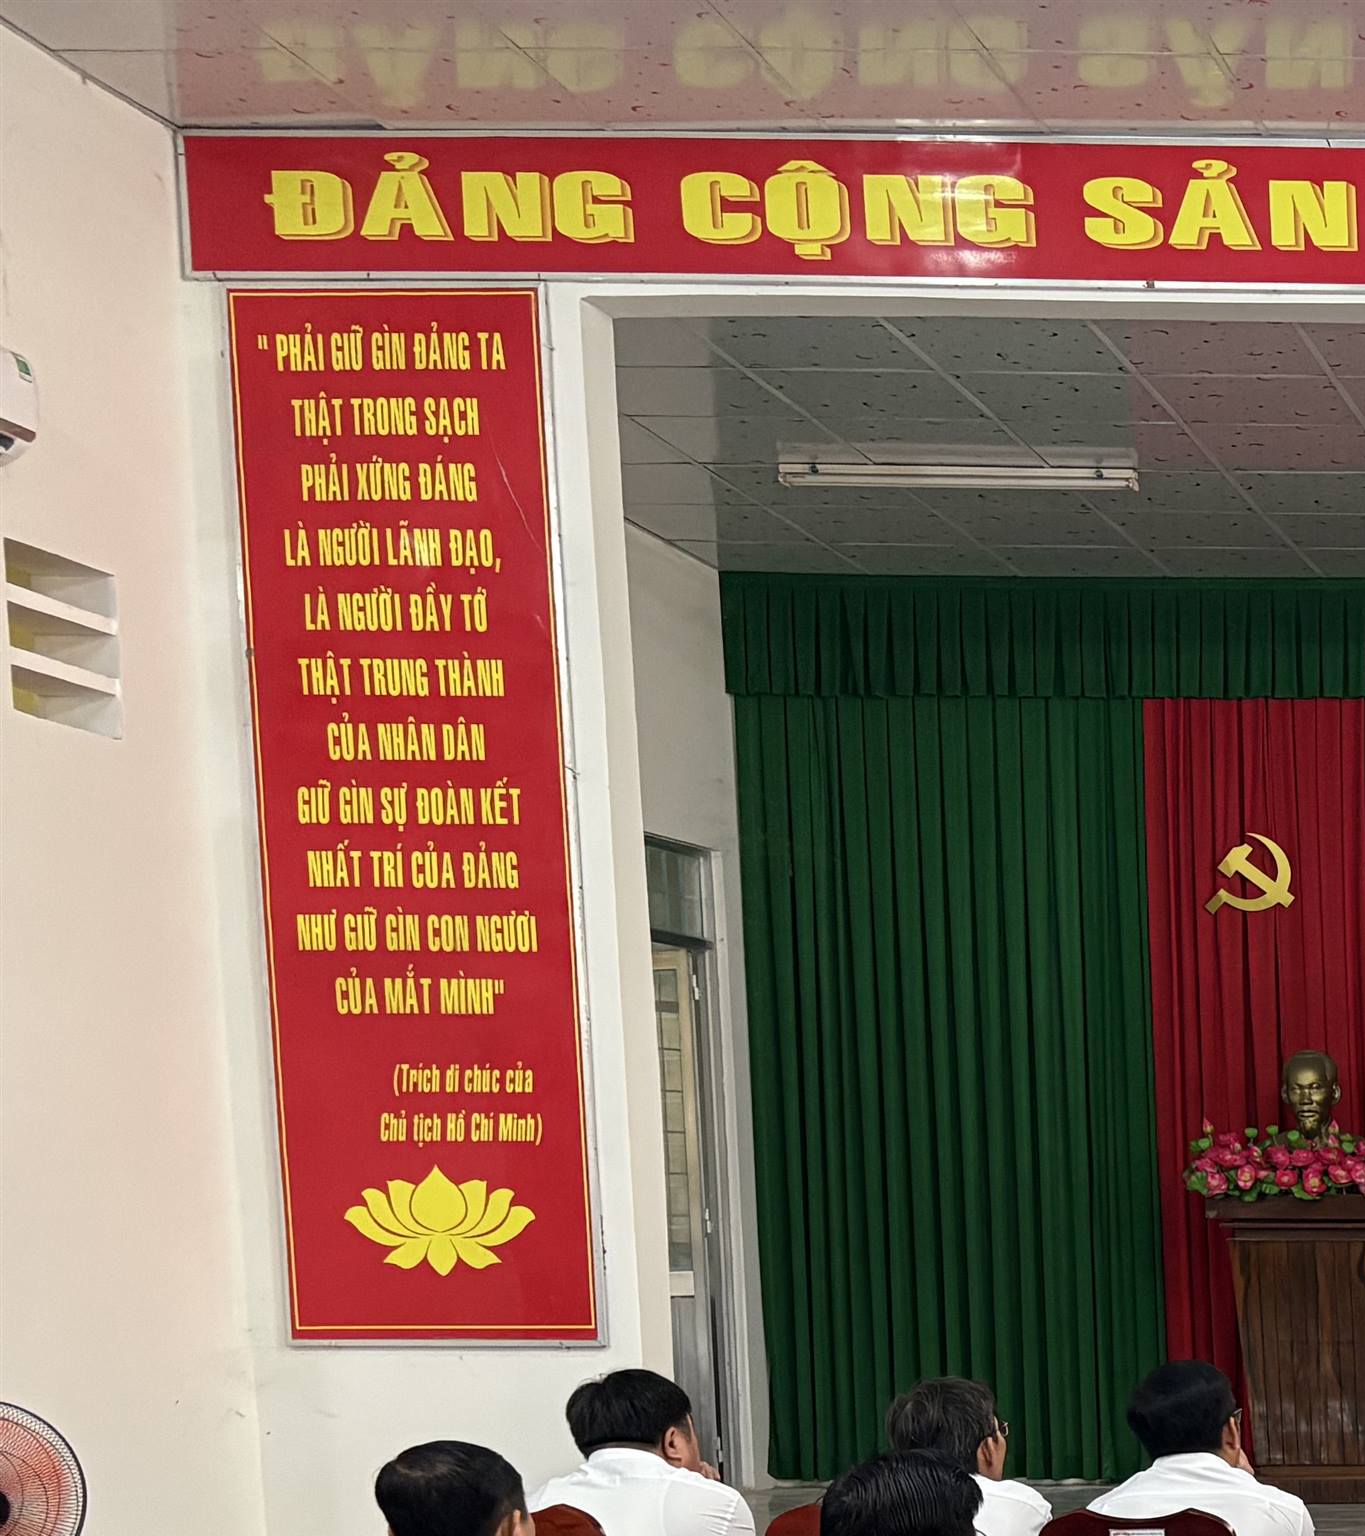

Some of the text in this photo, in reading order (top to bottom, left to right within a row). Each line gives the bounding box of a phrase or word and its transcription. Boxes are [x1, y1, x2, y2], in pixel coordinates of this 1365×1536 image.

[264, 152, 633, 243] ĐẢNG
[681, 158, 1035, 260] CỘNG
[1083, 159, 1357, 251] SẢN
[275, 322, 325, 372] PHẢI
[330, 324, 364, 372] GIỮ
[371, 324, 406, 371] GÌN
[412, 322, 471, 371] ĐẢNG
[476, 332, 506, 370] TA
[290, 391, 480, 446] THẬT TRONG SẠCH
[300, 452, 478, 503] PHẢI XỨNG ĐÁNG
[283, 519, 501, 575] LÀ NGƯỜI LÃNH ĐẠO,
[304, 587, 331, 631] LÀ
[337, 586, 403, 632] NGƯỜI
[408, 583, 453, 632] ĐẦY
[297, 650, 505, 705] THẬT TRUNG THÀNH
[326, 711, 486, 762] CỦA NHÂN DÂN
[297, 777, 521, 832] GIỮ GÌN SỰ ĐOÀN KẾT
[306, 840, 520, 890] NHẤT TRÍ CỦA ĐẢNG
[296, 910, 337, 952] NHƯ
[343, 906, 378, 952] GIỮ
[384, 907, 421, 952] GÌN
[426, 914, 470, 953] CON
[334, 967, 379, 1015] CỦA
[383, 963, 432, 1015] MẮT
[393, 1063, 534, 1096] (Trích di chúc của
[379, 1110, 543, 1146] Chủ tịch Hồ Chí Minh)
